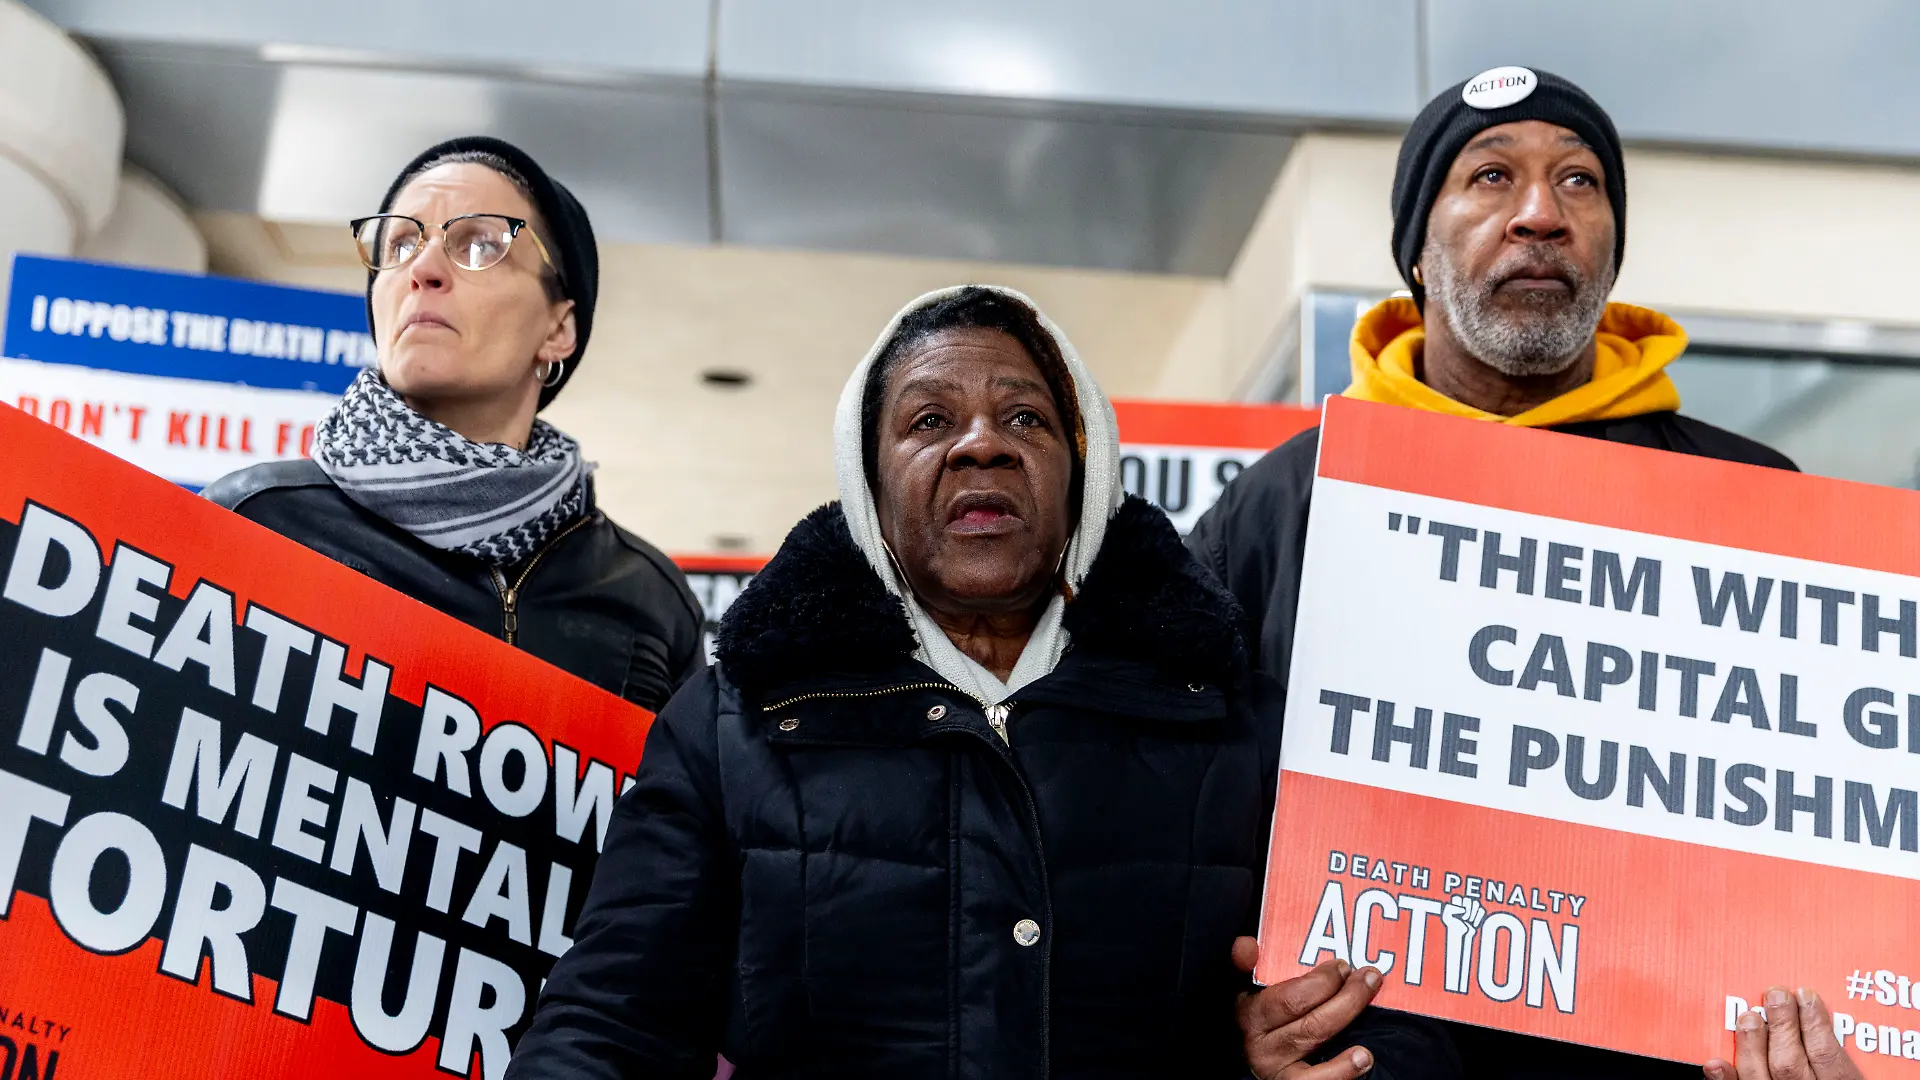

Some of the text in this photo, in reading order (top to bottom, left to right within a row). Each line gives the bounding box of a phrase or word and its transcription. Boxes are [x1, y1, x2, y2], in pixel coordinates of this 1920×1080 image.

[31, 295, 48, 332] I
[49, 297, 168, 346] OPPOSE
[170, 311, 228, 352] THE
[228, 318, 324, 364] DEATH
[167, 411, 252, 453] KILL
[1387, 511, 1918, 660] "THEM WITH
[3, 504, 637, 854] DEATH ROW
[1467, 624, 1818, 739] CAPITAL
[16, 647, 574, 958] IS MENTAL
[1318, 688, 1919, 853] THE PUNISHM
[0, 769, 547, 1080] TORTUR
[1327, 850, 1586, 917] DEATH PENALTY
